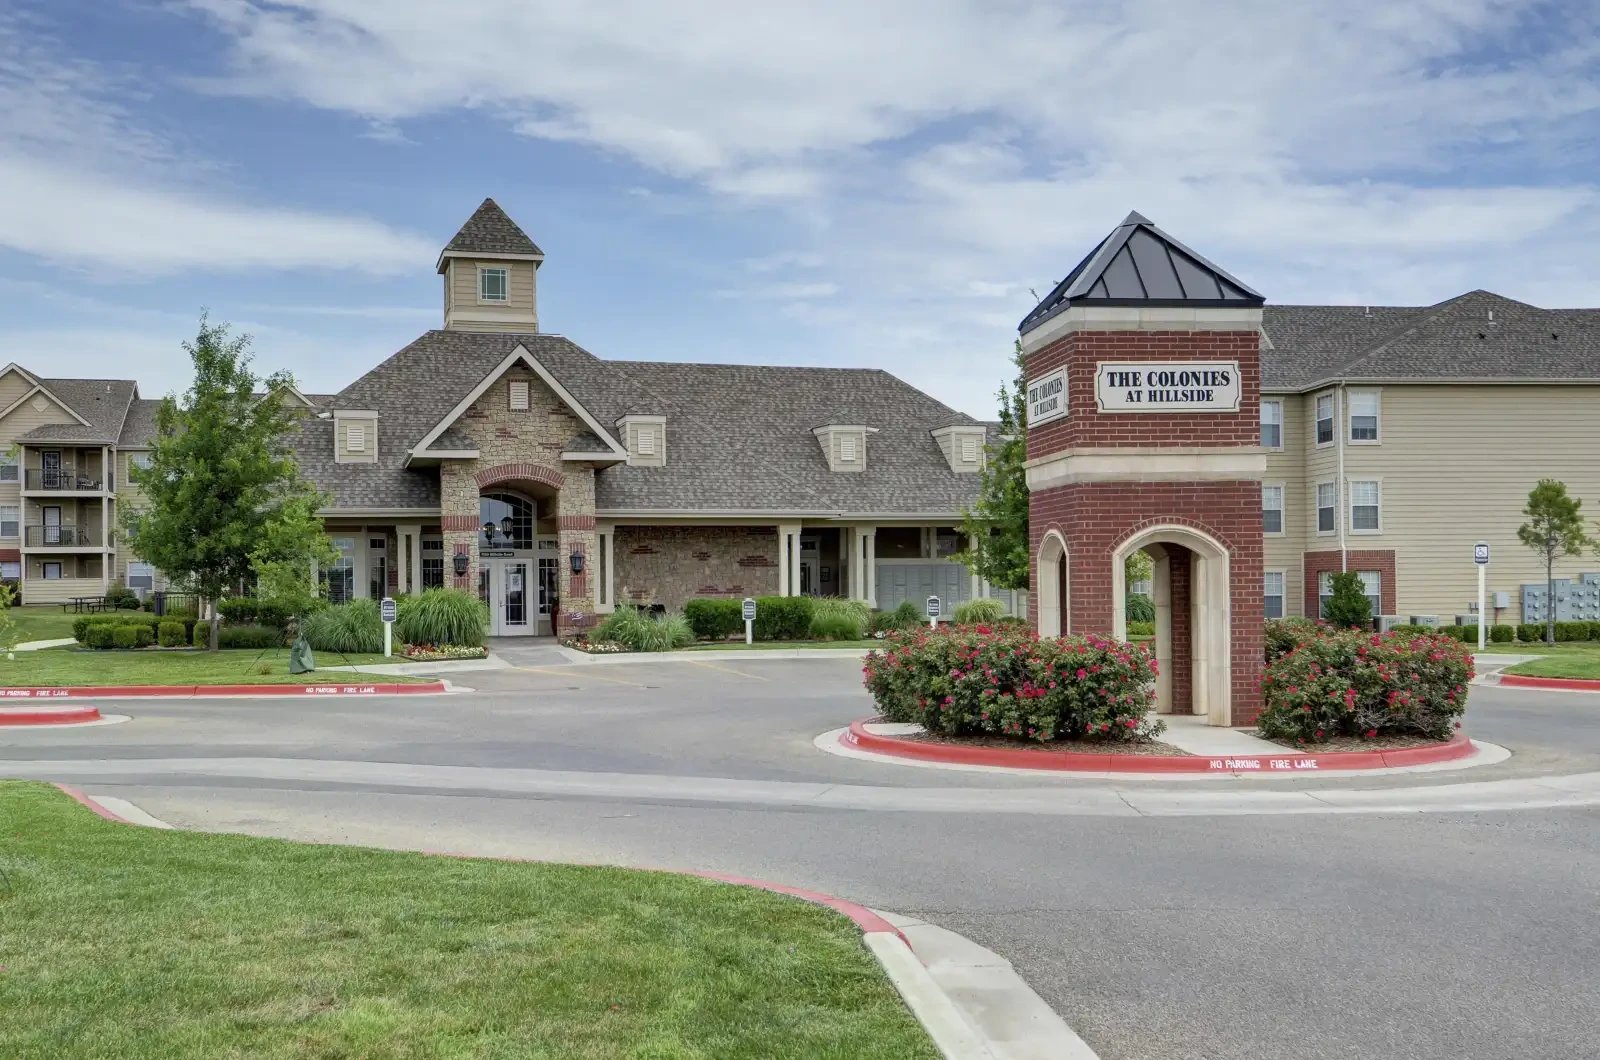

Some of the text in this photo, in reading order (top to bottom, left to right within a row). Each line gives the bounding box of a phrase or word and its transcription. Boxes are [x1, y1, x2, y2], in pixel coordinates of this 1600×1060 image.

[1107, 371, 1230, 387] THE COLONIES
[1029, 377, 1063, 404] THE COLONIES
[1125, 390, 1214, 402] AT HILLSIDE
[1210, 759, 1318, 769] NO PARKING FIRE LANE
